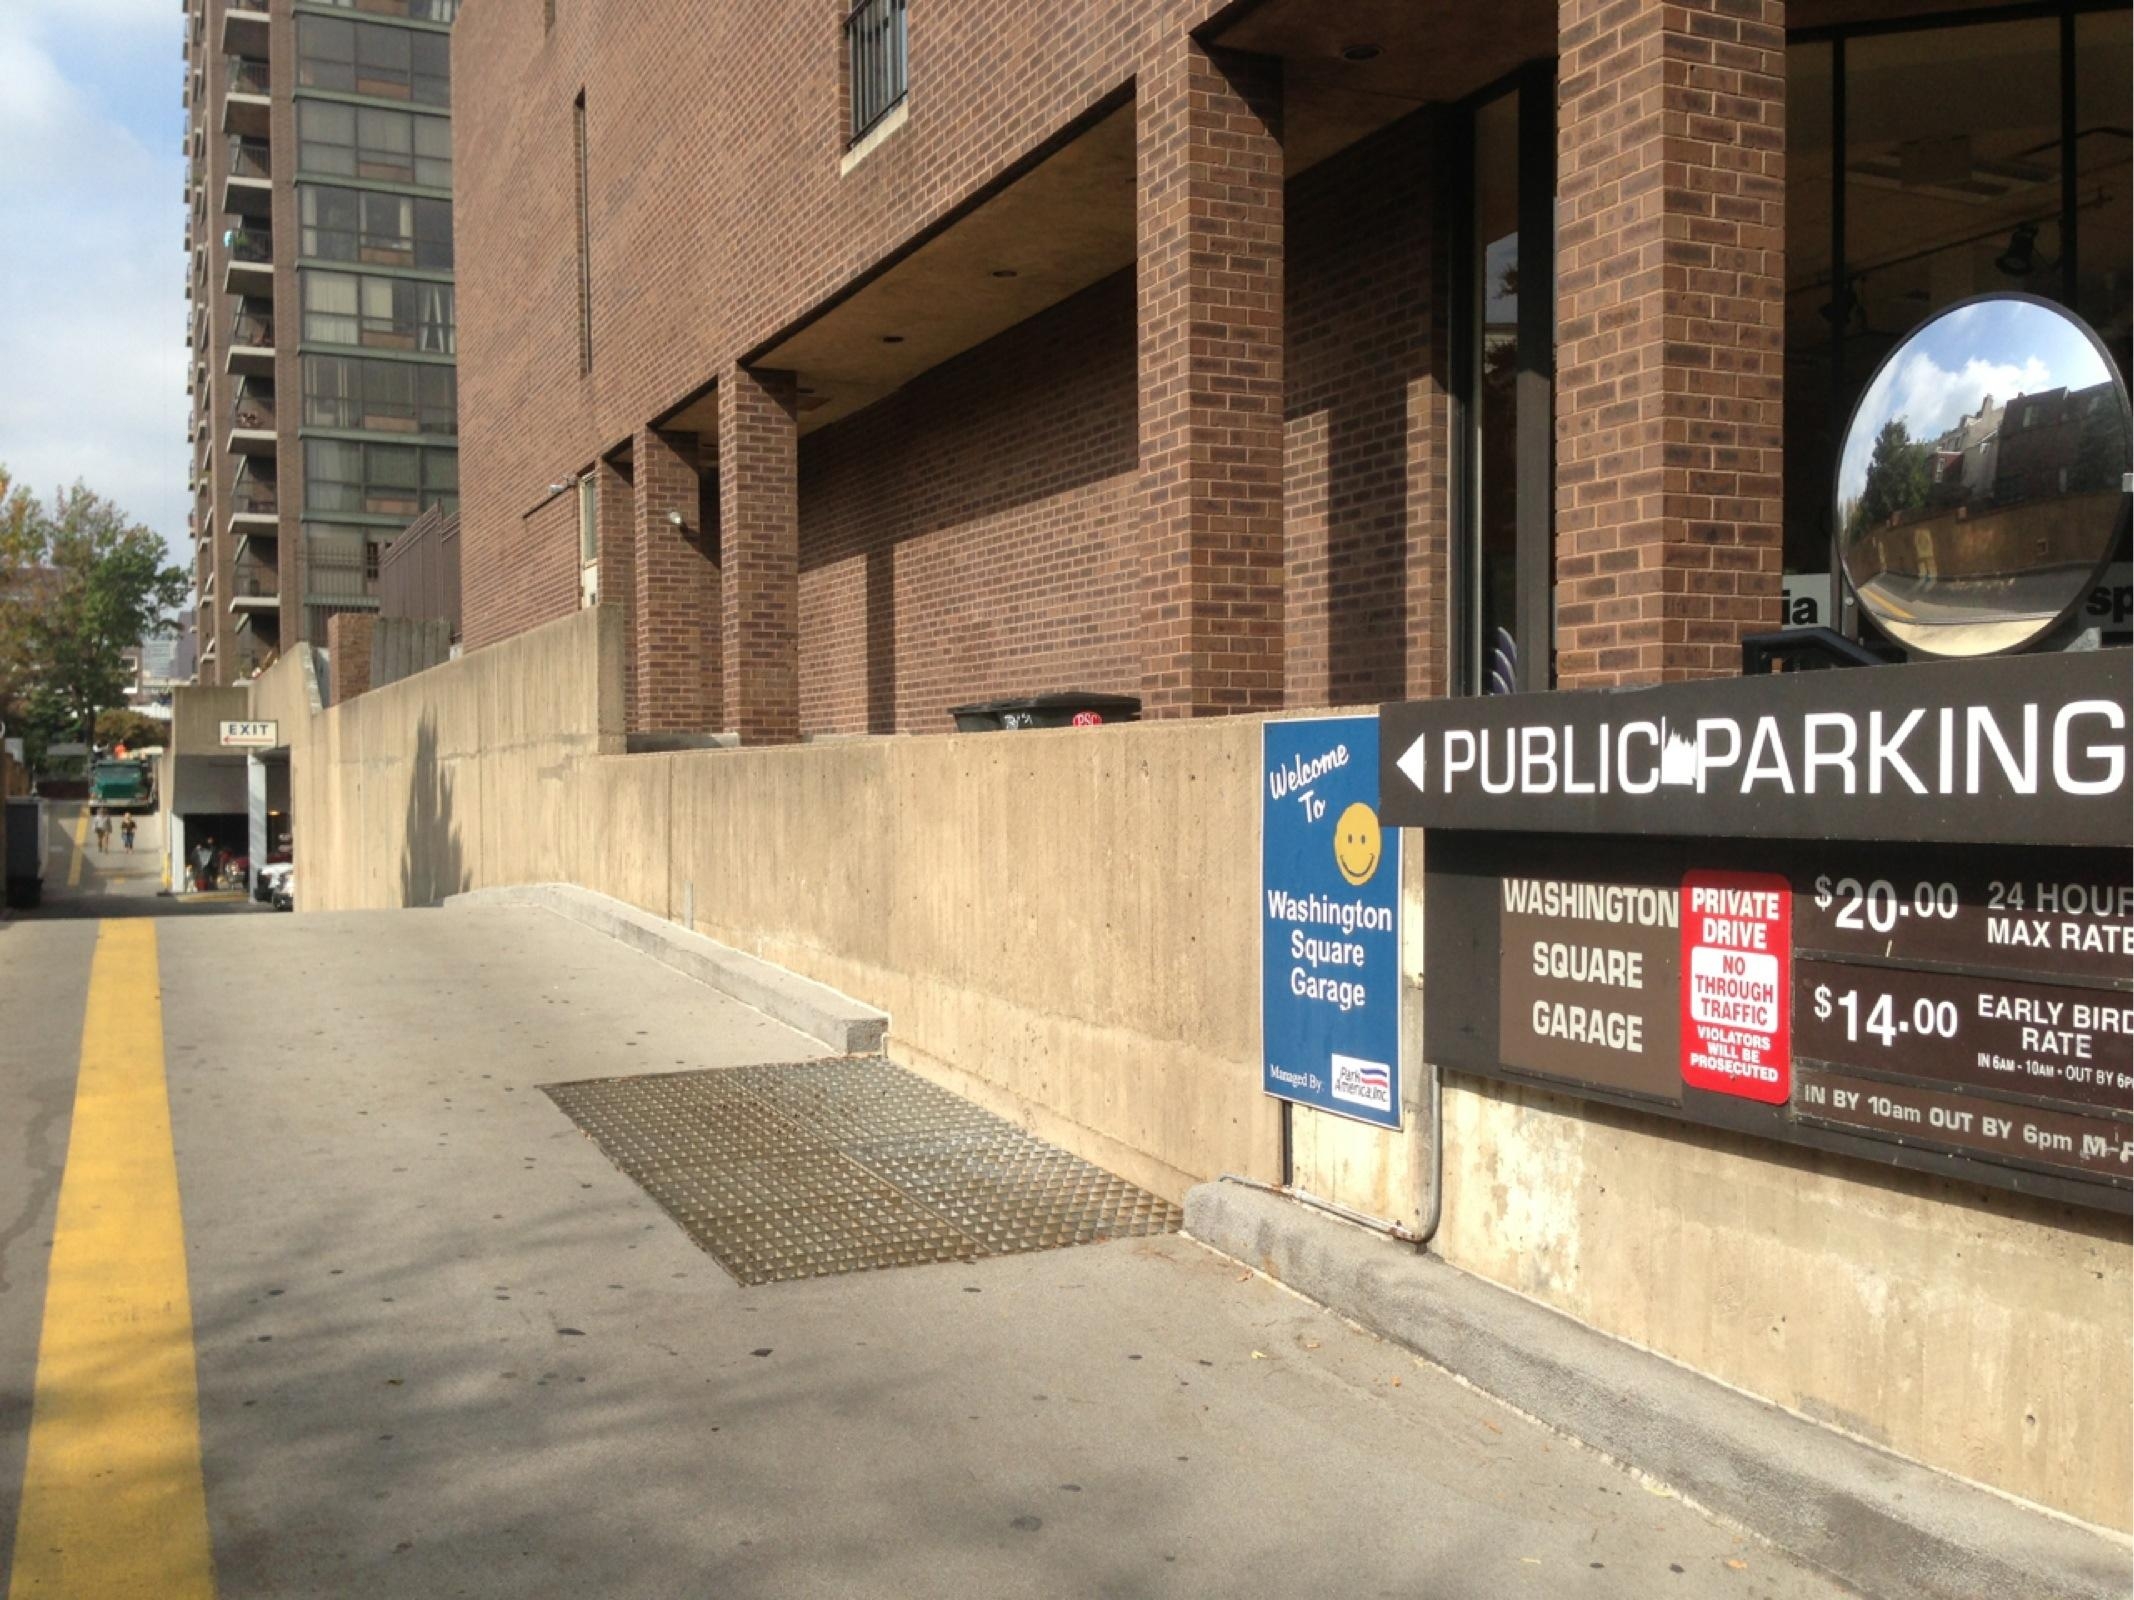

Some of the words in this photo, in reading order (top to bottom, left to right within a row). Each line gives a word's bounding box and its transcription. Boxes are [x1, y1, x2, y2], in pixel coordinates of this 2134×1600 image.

[228, 723, 269, 736] EXIT
[1443, 721, 1660, 794] PUBLIC
[1696, 700, 2126, 795] PARKING
[1269, 744, 1349, 800] Welcome
[1297, 789, 1326, 823] To
[1267, 889, 1393, 935] Washington
[1502, 877, 1680, 929] WASHINGTON
[1691, 886, 1780, 921] PRIVATE
[1814, 873, 1958, 933] $20.00
[1987, 881, 2024, 911] 24
[1291, 929, 1365, 968] Square
[1702, 917, 1767, 950] DRIVE
[1987, 916, 2052, 949] MAX
[2061, 921, 2133, 955] RATE
[1532, 940, 1643, 989] SQUARE
[1722, 954, 1746, 976] NO
[1291, 966, 1366, 1012] Garage
[1694, 974, 1774, 1004] THROUGH
[1532, 1000, 1643, 1053] GARAGE
[1701, 997, 1768, 1026] TRAFFIC
[1814, 984, 1958, 1047] $14.00
[1977, 993, 2064, 1026] EARLY
[2072, 1003, 2133, 1035] BIRD
[1697, 1024, 1771, 1051] VIOLATORS
[1706, 1041, 1739, 1060] WILL
[1741, 1046, 1761, 1064] BE
[2021, 1026, 2093, 1060] RATE
[1269, 1063, 1308, 1089] Managed
[1340, 1065, 1361, 1083] Park
[1689, 1052, 1779, 1083] PROSECUTED
[1977, 1052, 1991, 1068] IN
[2065, 1064, 2093, 1083] OUT
[2095, 1068, 2114, 1087] BY
[1804, 1084, 1826, 1105] IN
[1832, 1088, 1861, 1111] BY
[1867, 1096, 1921, 1124] 10am
[1929, 1107, 1974, 1133] OUT
[1981, 1115, 2013, 1139] BY
[2023, 1123, 2073, 1151] 6pm
